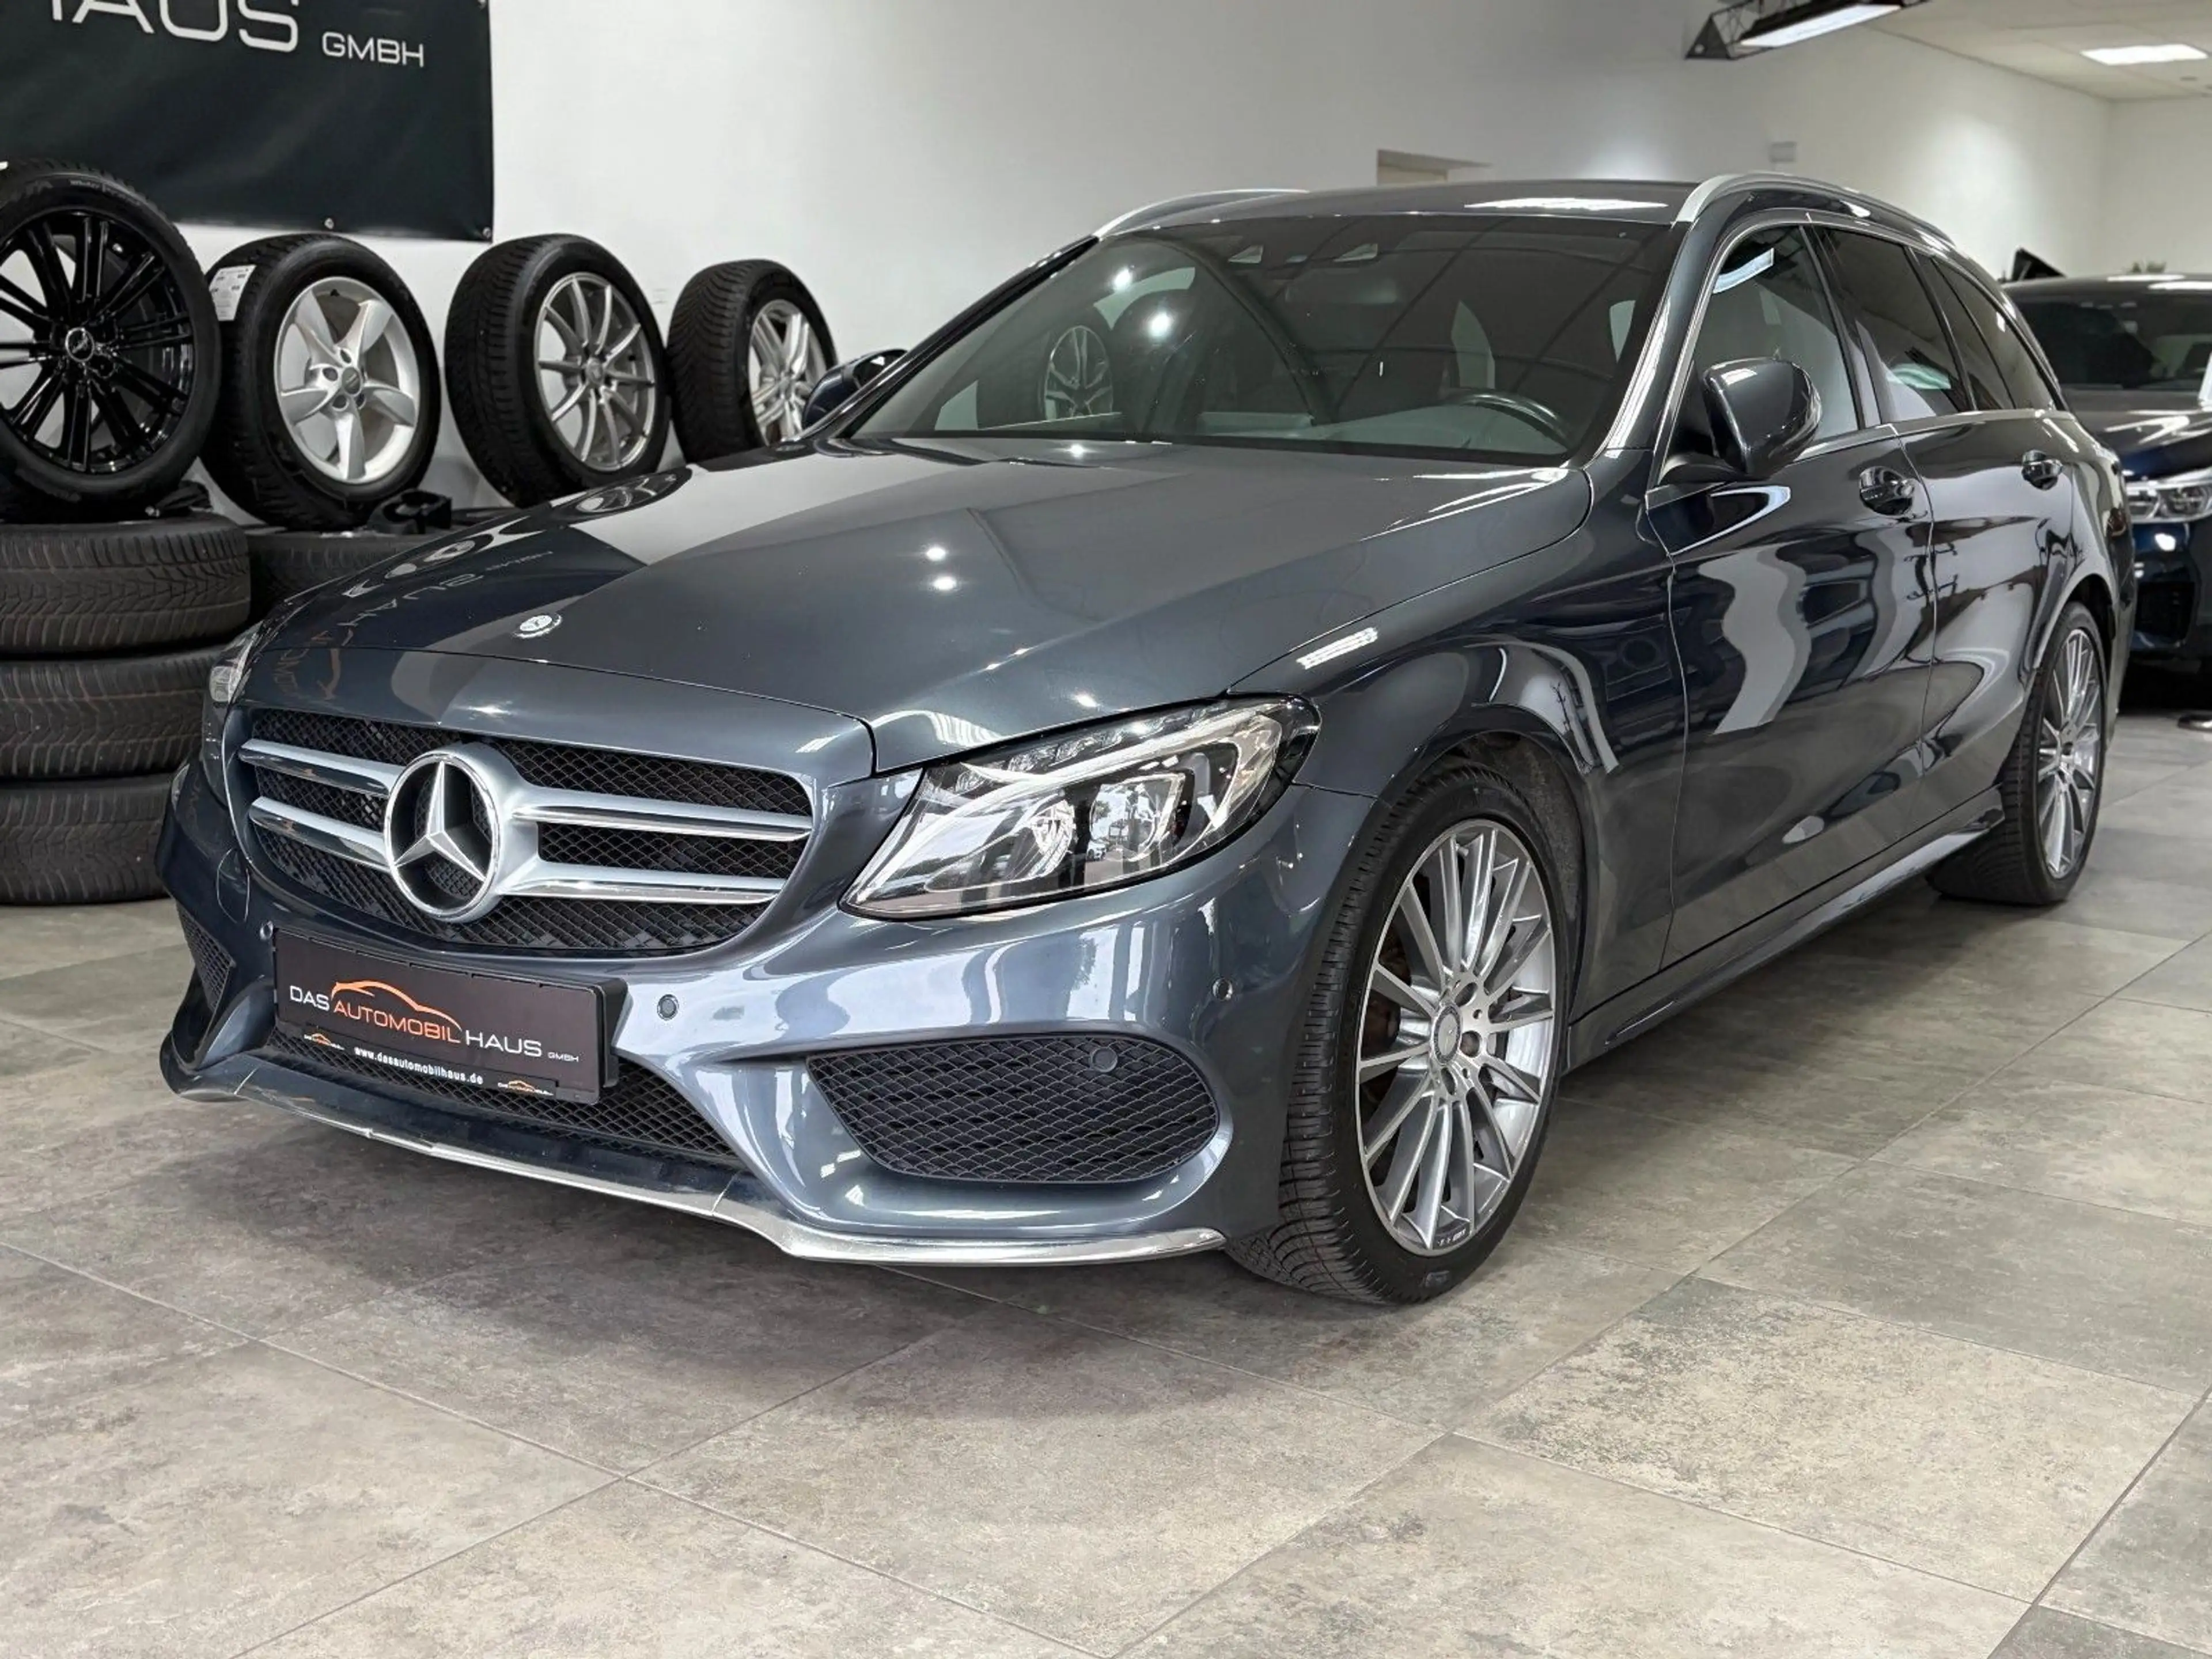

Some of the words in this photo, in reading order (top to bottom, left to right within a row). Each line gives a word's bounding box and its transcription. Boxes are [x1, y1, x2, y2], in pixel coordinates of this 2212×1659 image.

[52, 0, 298, 52] AUS
[321, 31, 425, 68] GMBH
[290, 985, 330, 1011] DAS
[333, 999, 461, 1043] AUTOMOBIL
[465, 1029, 543, 1057] HAUS
[548, 1051, 579, 1063] GMBH
[354, 1046, 484, 1085] www.dasautomobilhaus.de
